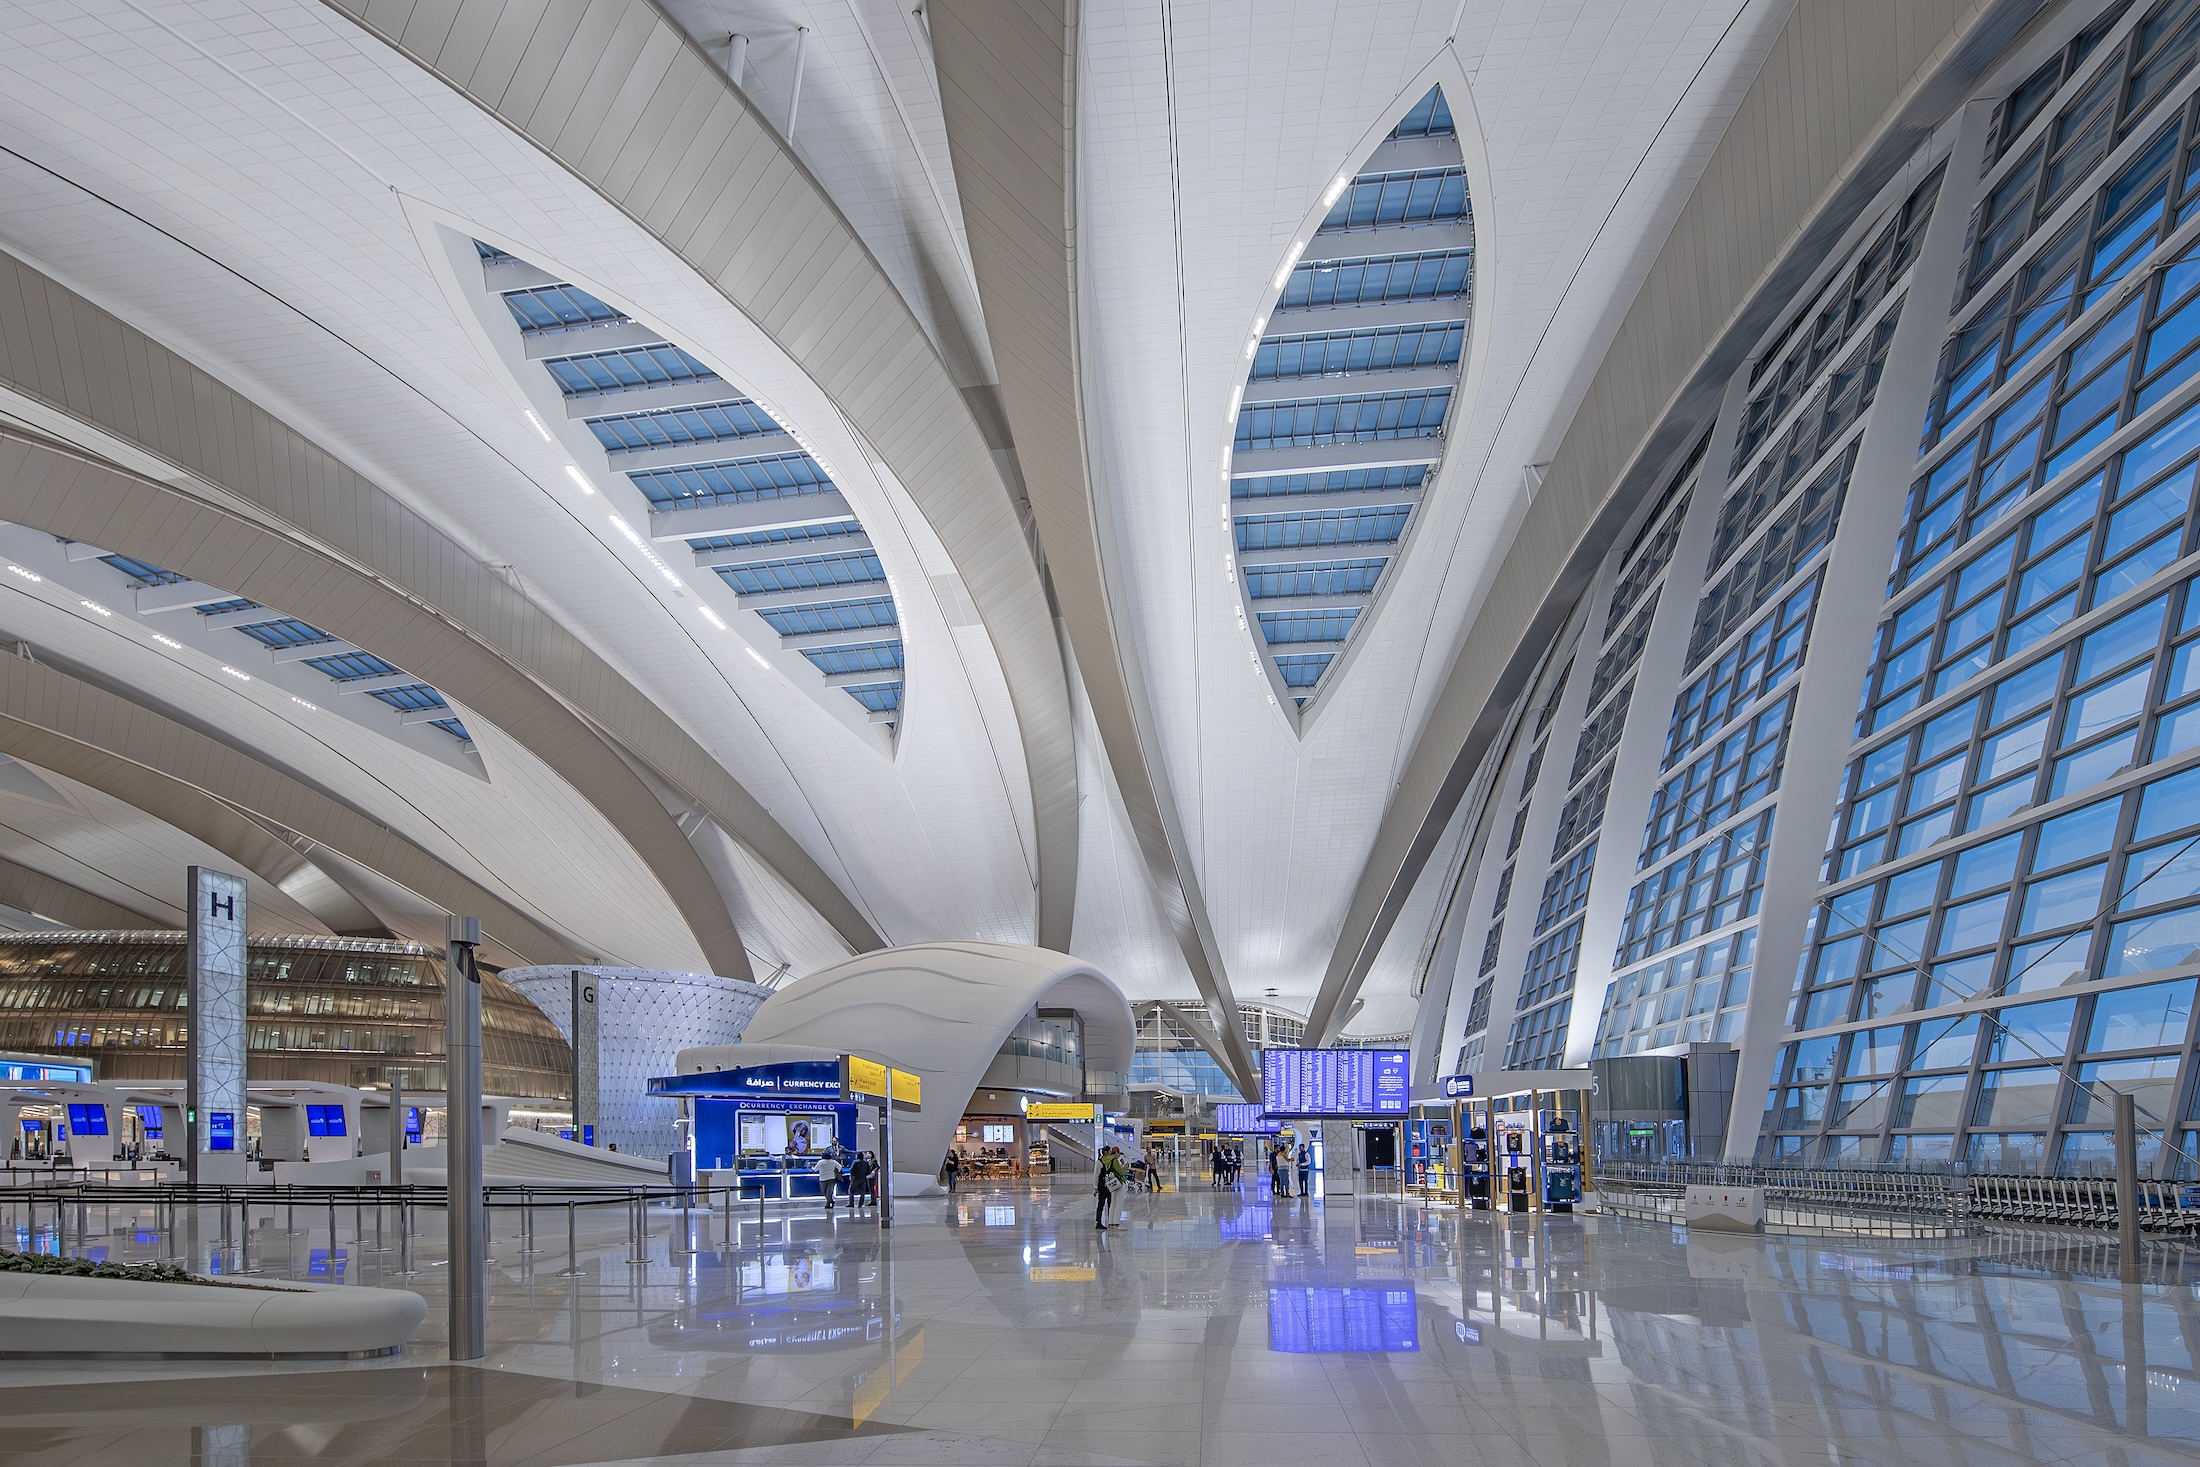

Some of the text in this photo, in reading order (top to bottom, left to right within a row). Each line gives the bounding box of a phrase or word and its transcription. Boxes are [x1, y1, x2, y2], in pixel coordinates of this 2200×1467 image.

[211, 892, 233, 921] H
[583, 986, 594, 1004] G
[745, 1077, 774, 1088] صرافة
[783, 1079, 823, 1089] CURRENCY
[1592, 1076, 1600, 1096] 5
